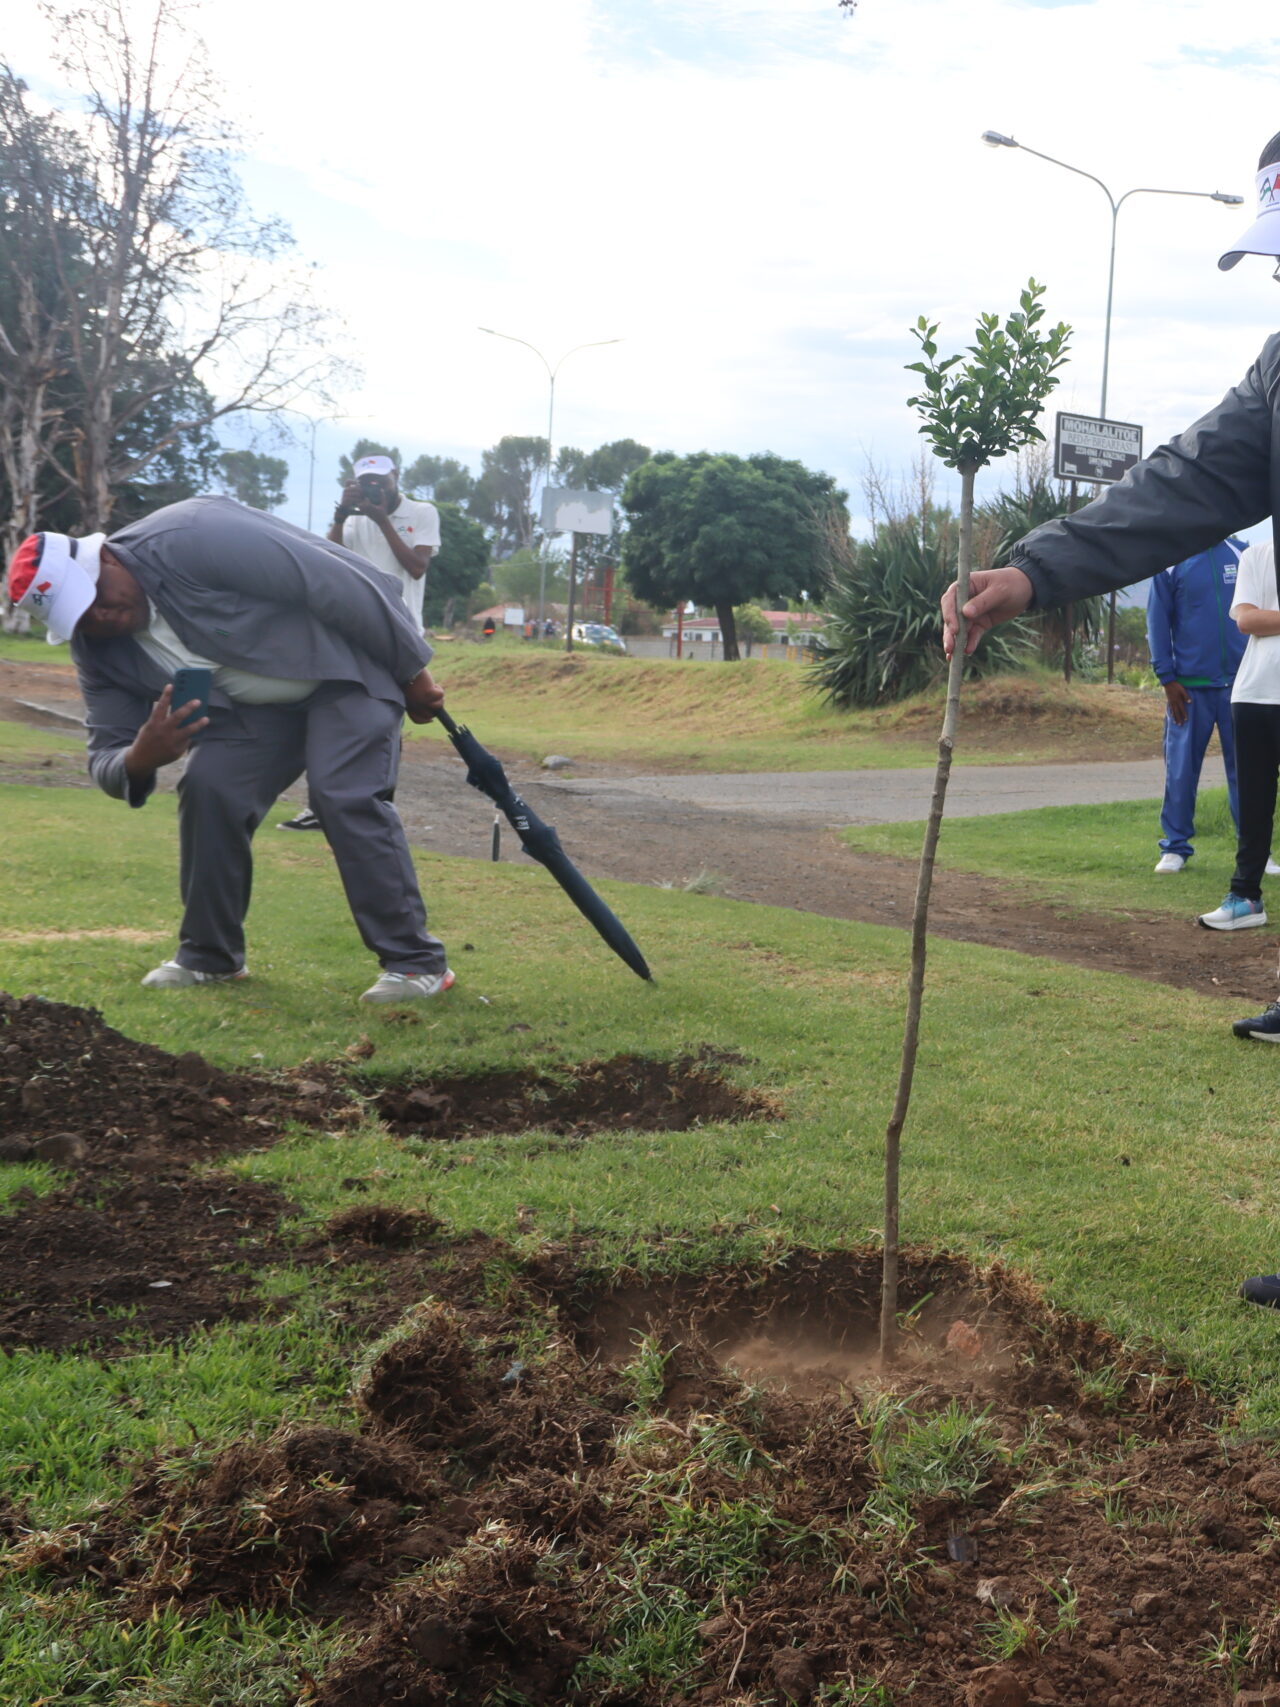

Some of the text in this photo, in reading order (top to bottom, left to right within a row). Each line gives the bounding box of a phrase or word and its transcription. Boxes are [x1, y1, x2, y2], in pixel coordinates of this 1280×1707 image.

[1063, 419, 1137, 442] MOHALALITOE
[1067, 432, 1083, 444] BED
[1092, 436, 1135, 452] BREAKFAST
